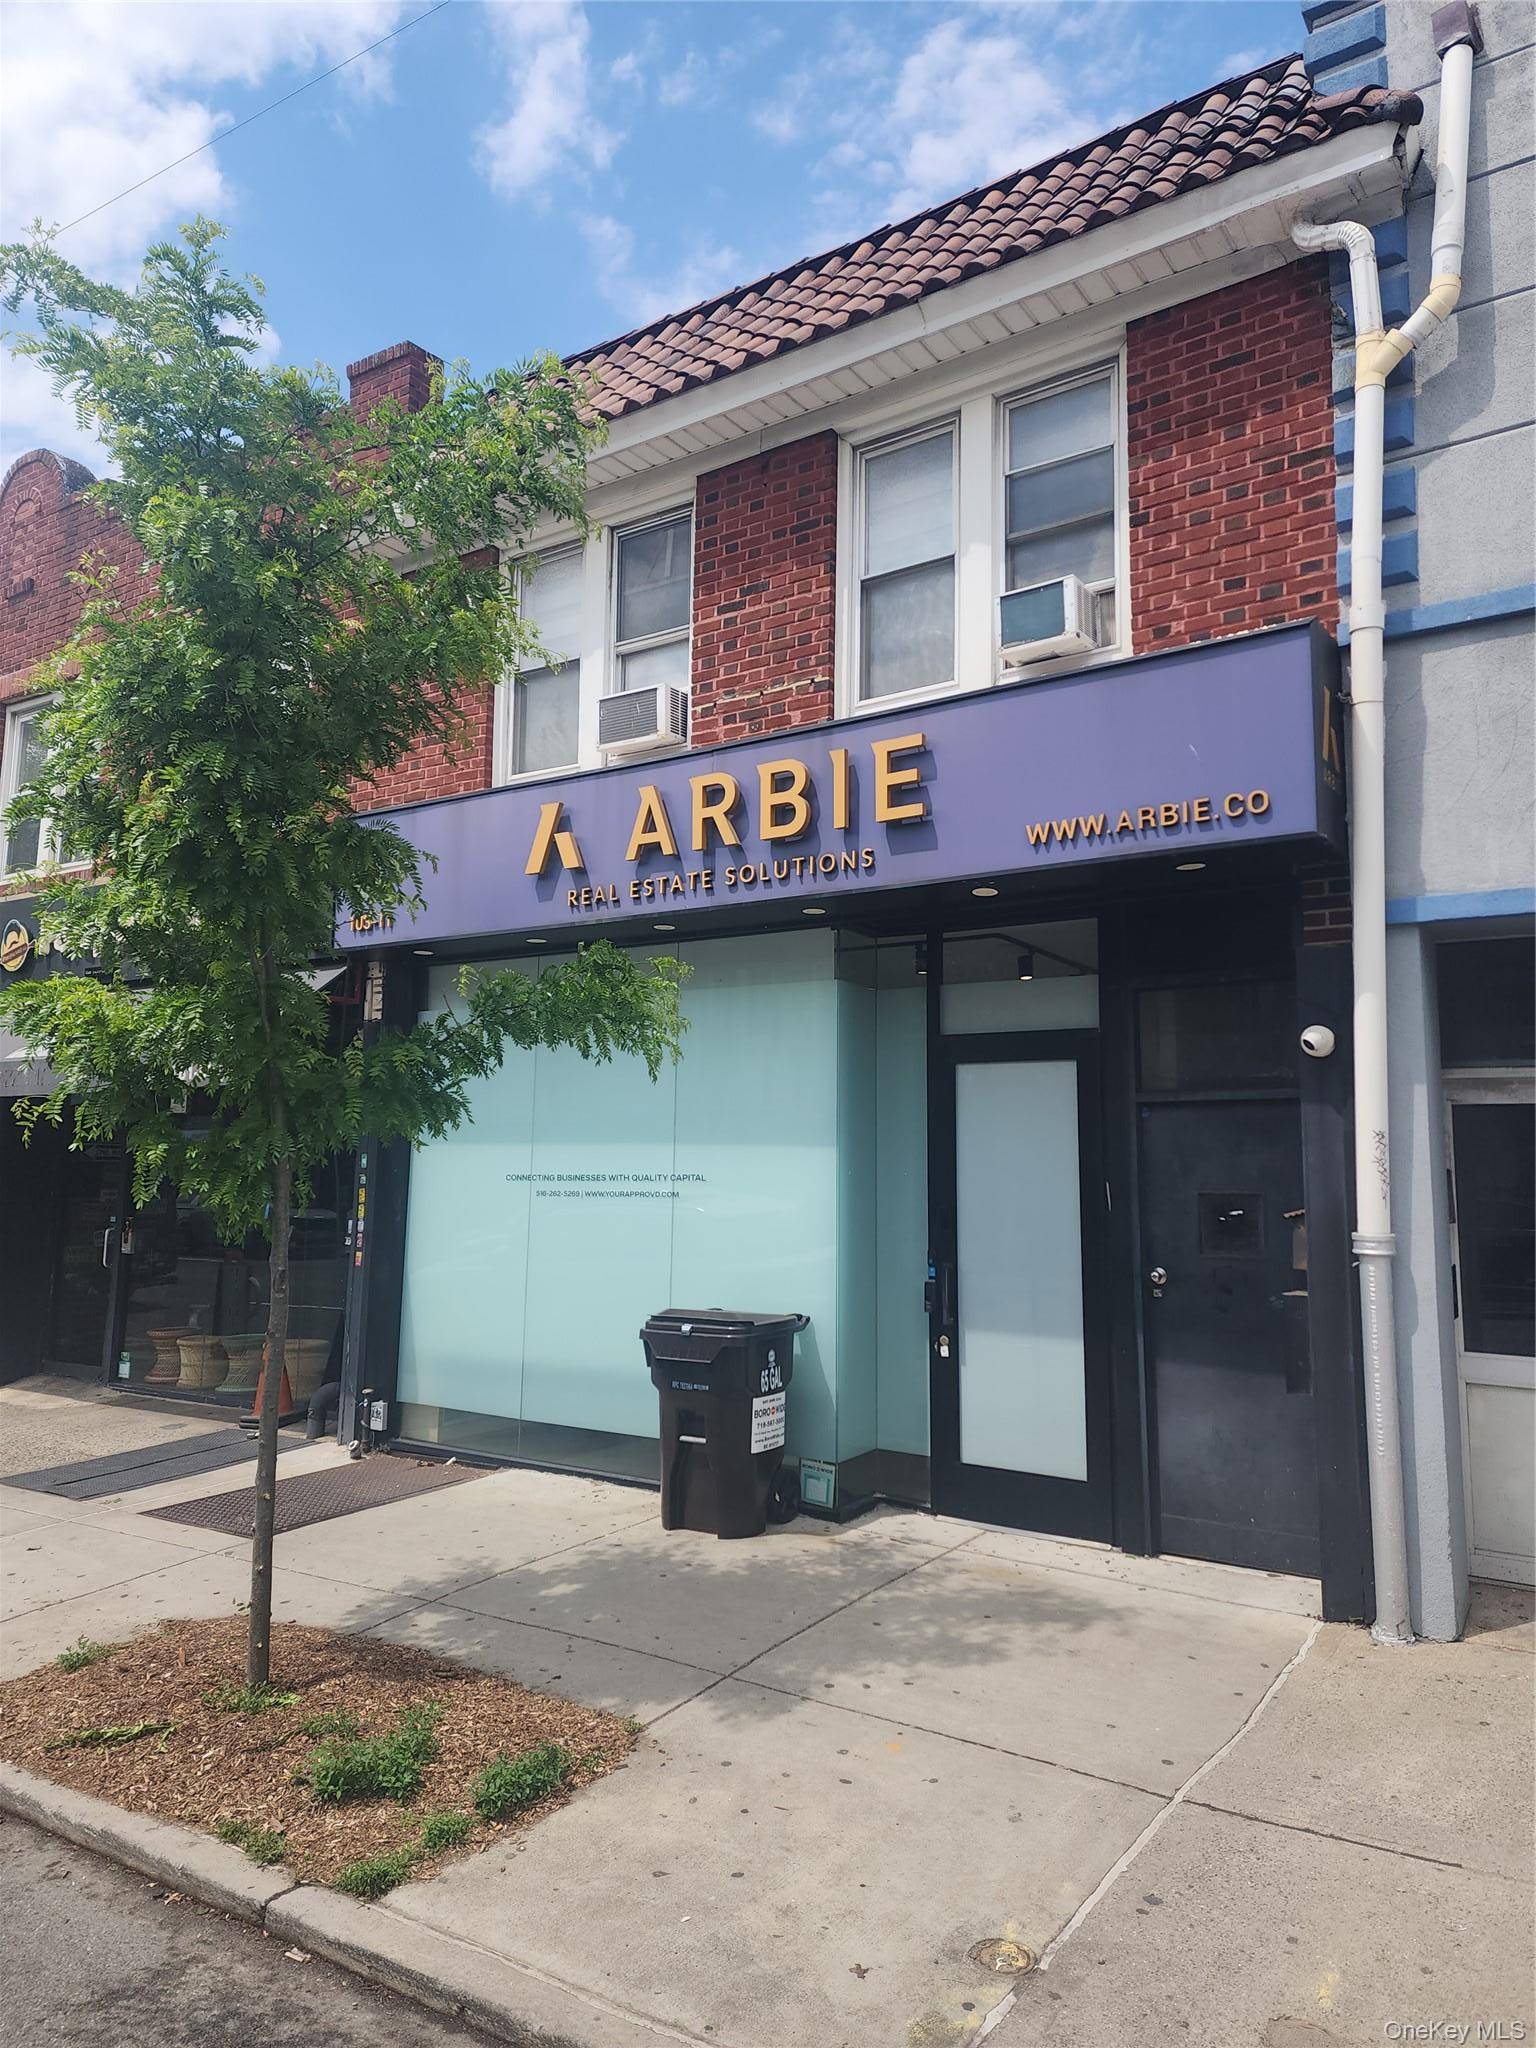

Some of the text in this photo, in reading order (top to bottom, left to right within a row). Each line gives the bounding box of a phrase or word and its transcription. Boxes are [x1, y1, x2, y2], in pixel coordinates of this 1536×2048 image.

[625, 732, 927, 861] ARBIE
[1025, 789, 1271, 847] WWW.ARBIE.CO
[567, 848, 875, 907] REAL ESTATE SOLUTIONS
[608, 1174, 630, 1182] WITH
[631, 1174, 668, 1182] QUALITY
[670, 1174, 706, 1182] CAPITAL
[760, 1366, 783, 1393] 65 GAL
[754, 1407, 770, 1419] BORO
